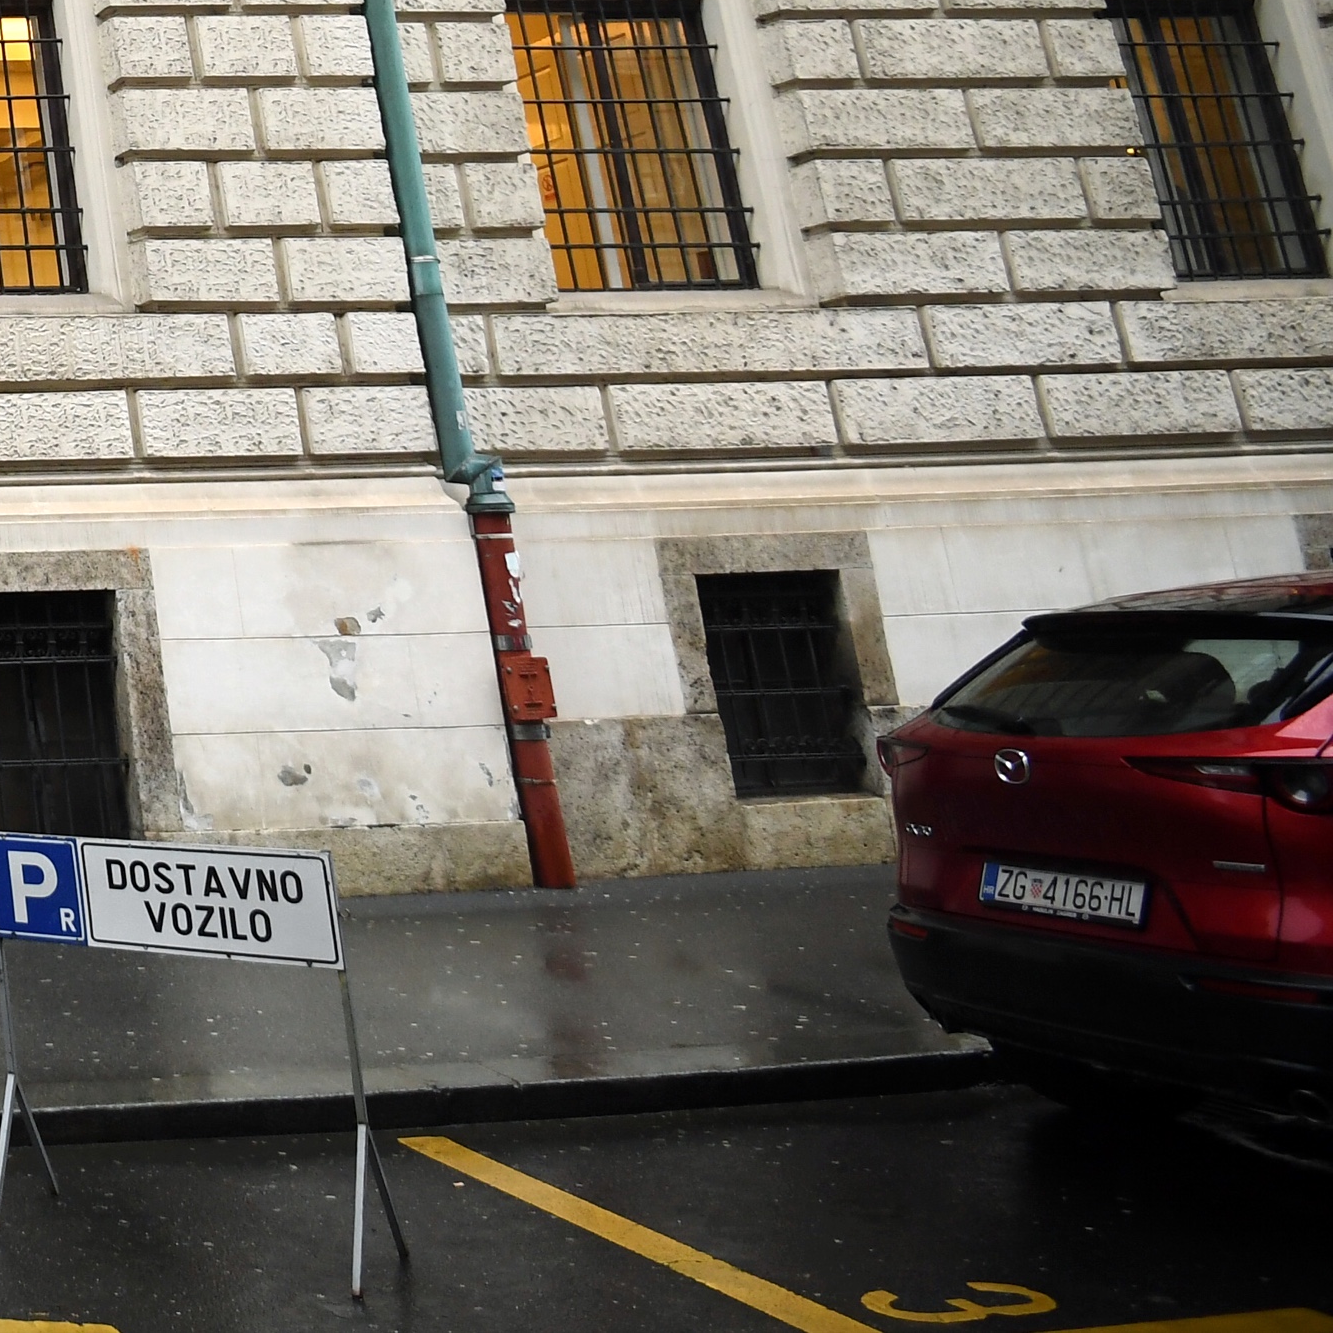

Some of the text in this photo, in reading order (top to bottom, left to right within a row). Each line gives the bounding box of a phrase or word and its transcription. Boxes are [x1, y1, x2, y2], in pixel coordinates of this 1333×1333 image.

[8, 850, 58, 923] P
[105, 858, 304, 904] DOSTAVNO
[983, 885, 995, 895] HR
[997, 869, 1028, 900] ZG
[61, 907, 77, 933] R
[144, 900, 272, 943] VOZILO
